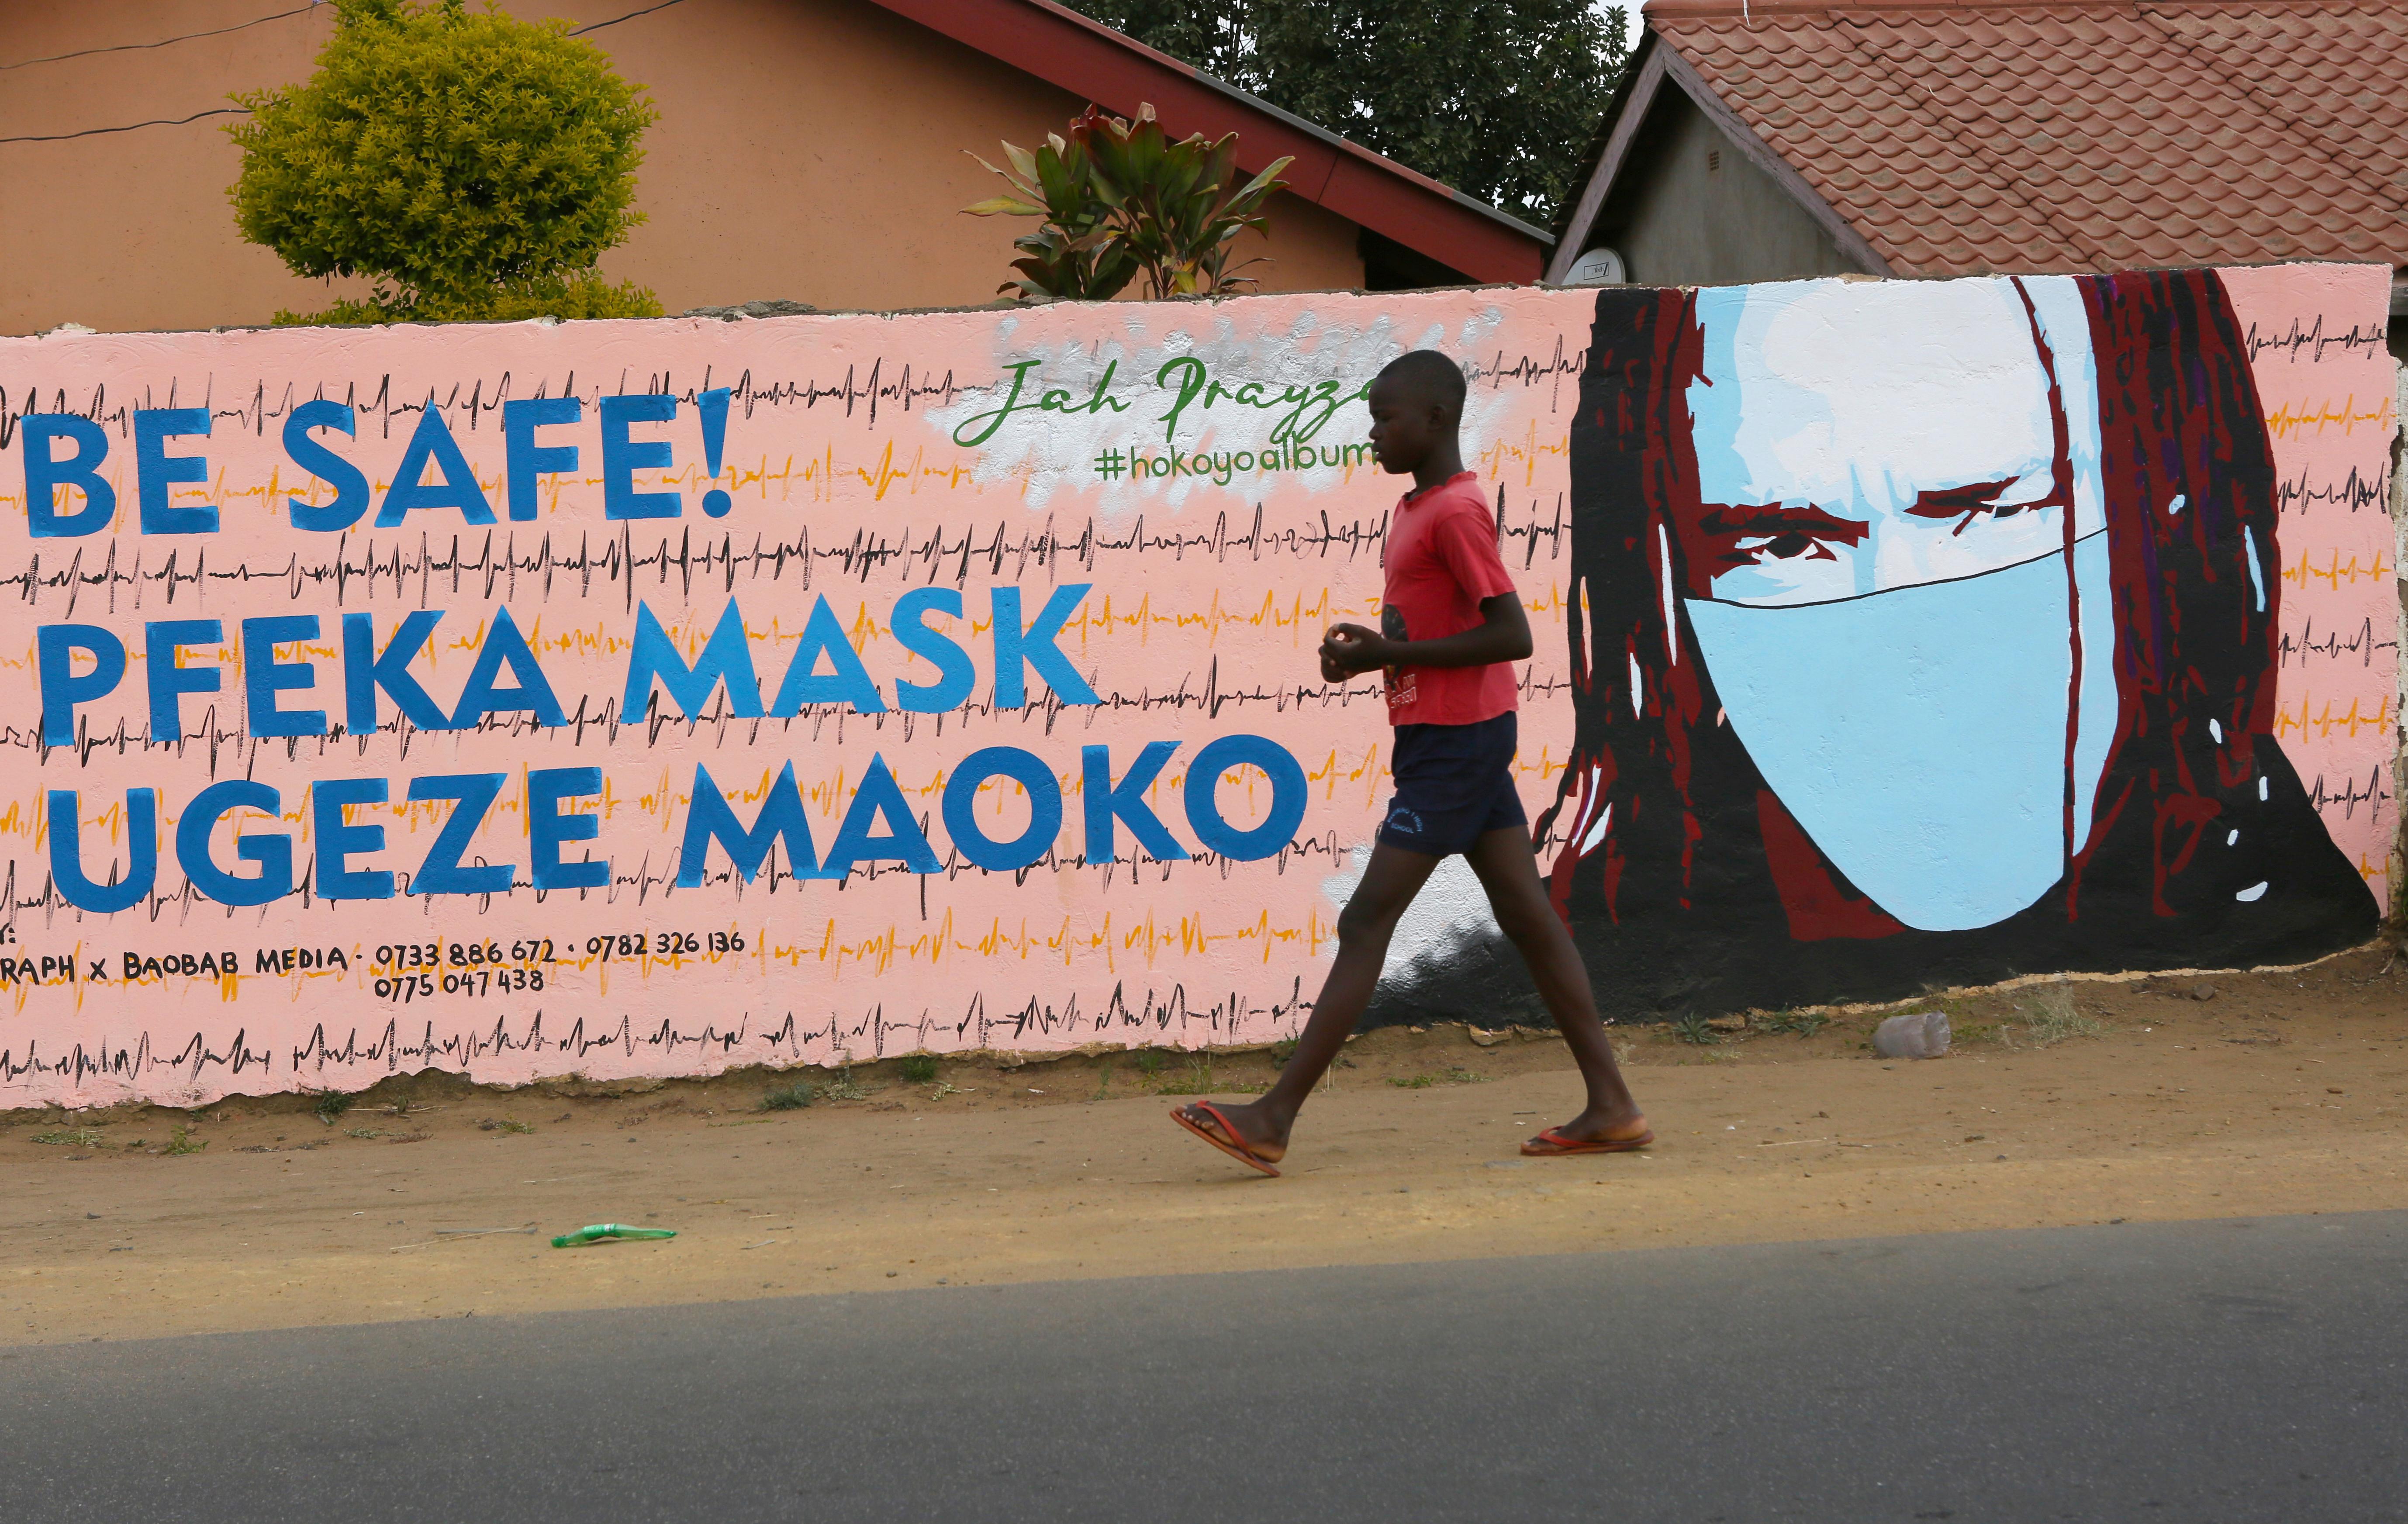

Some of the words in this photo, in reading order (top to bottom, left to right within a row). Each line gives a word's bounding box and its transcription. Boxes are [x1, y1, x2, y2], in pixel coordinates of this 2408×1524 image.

[18, 407, 221, 538] BE
[282, 386, 732, 532] SAFE!
[953, 359, 1131, 447] Jah
[37, 605, 568, 748] PFEKA
[620, 583, 1103, 725] MASK
[48, 766, 611, 914] UGEZE
[675, 734, 1308, 889] MAOKO
[124, 952, 238, 979] BAOBAB
[256, 947, 348, 974] MEDIA
[376, 943, 440, 971] 0733
[449, 943, 503, 966] 886
[511, 939, 557, 963] 672
[586, 933, 648, 962] 0782
[656, 932, 700, 954] 326
[708, 932, 745, 953] 136
[374, 976, 434, 1004] 0775
[442, 972, 489, 997] 047
[497, 969, 544, 995] 438
